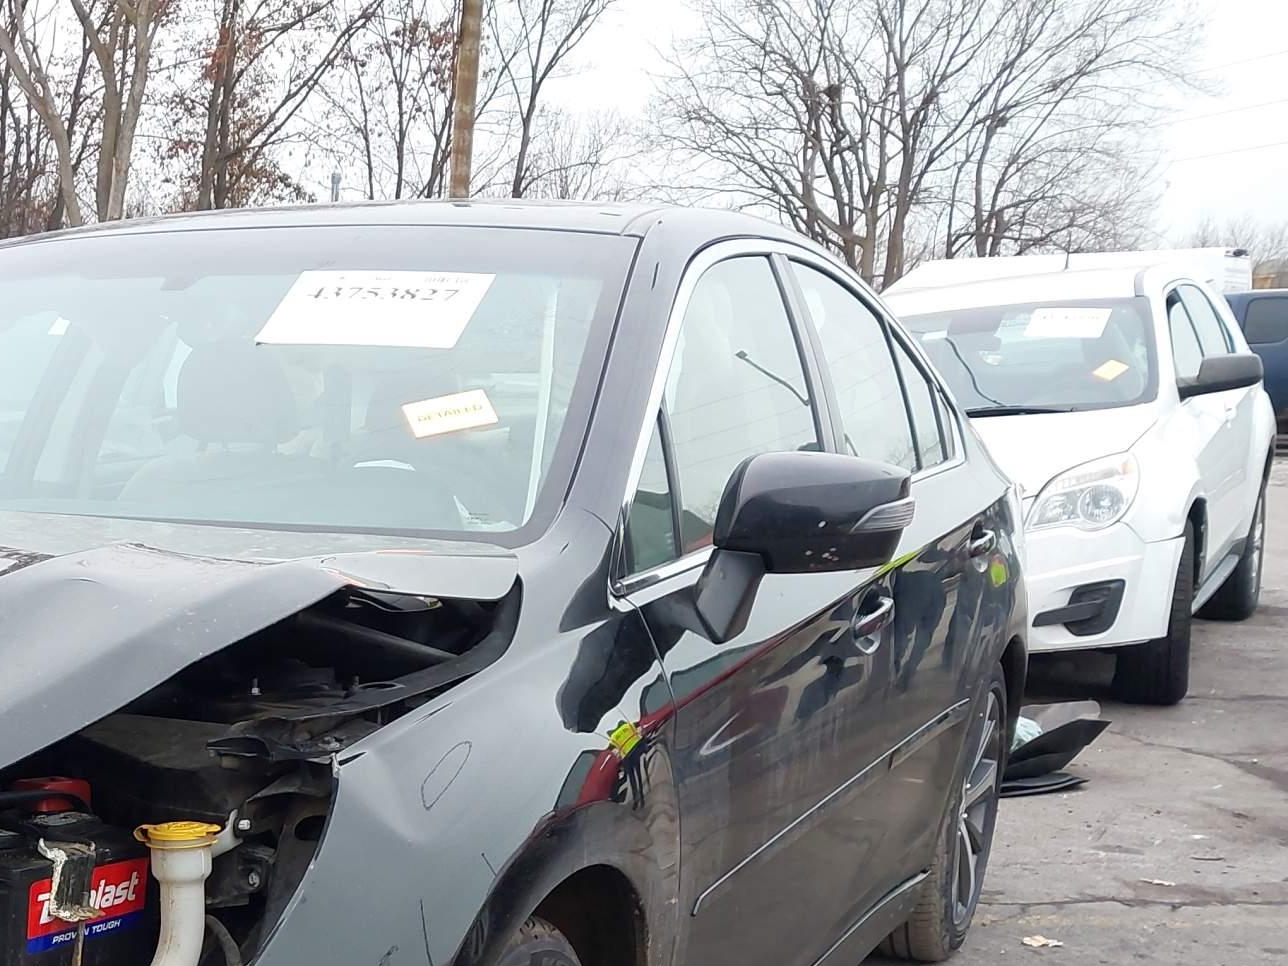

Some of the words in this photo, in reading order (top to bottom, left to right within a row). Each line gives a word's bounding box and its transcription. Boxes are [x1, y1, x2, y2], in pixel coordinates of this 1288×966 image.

[306, 286, 460, 302] 43753827
[52, 926, 90, 945] PROVN
[92, 918, 122, 935] TOUGH
